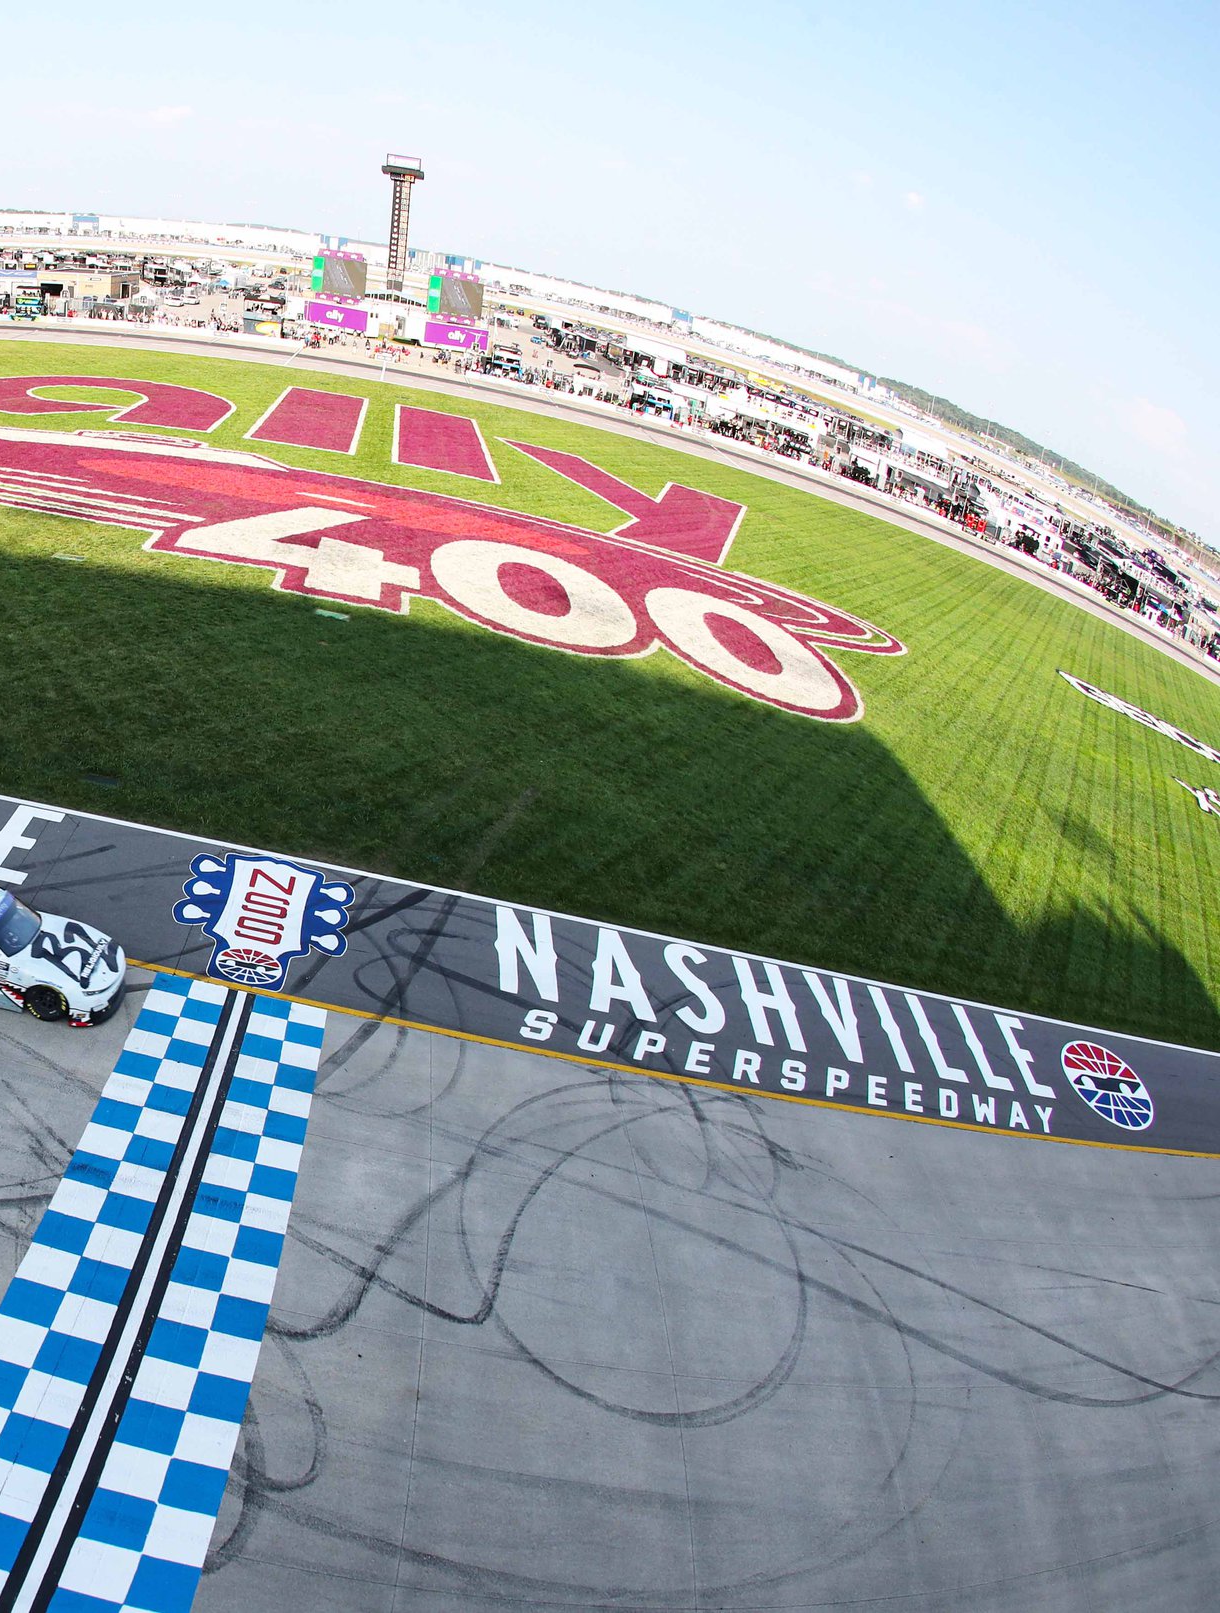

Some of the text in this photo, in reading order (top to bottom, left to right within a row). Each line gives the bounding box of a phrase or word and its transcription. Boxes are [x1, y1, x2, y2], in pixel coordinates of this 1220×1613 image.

[325, 309, 345, 323] ally
[447, 330, 467, 343] ally
[175, 506, 846, 714] 400
[1056, 669, 1220, 765] GEIC
[494, 905, 1056, 1099] NASHVILLE
[519, 1009, 1053, 1134] SUPERSPEEDWAY
